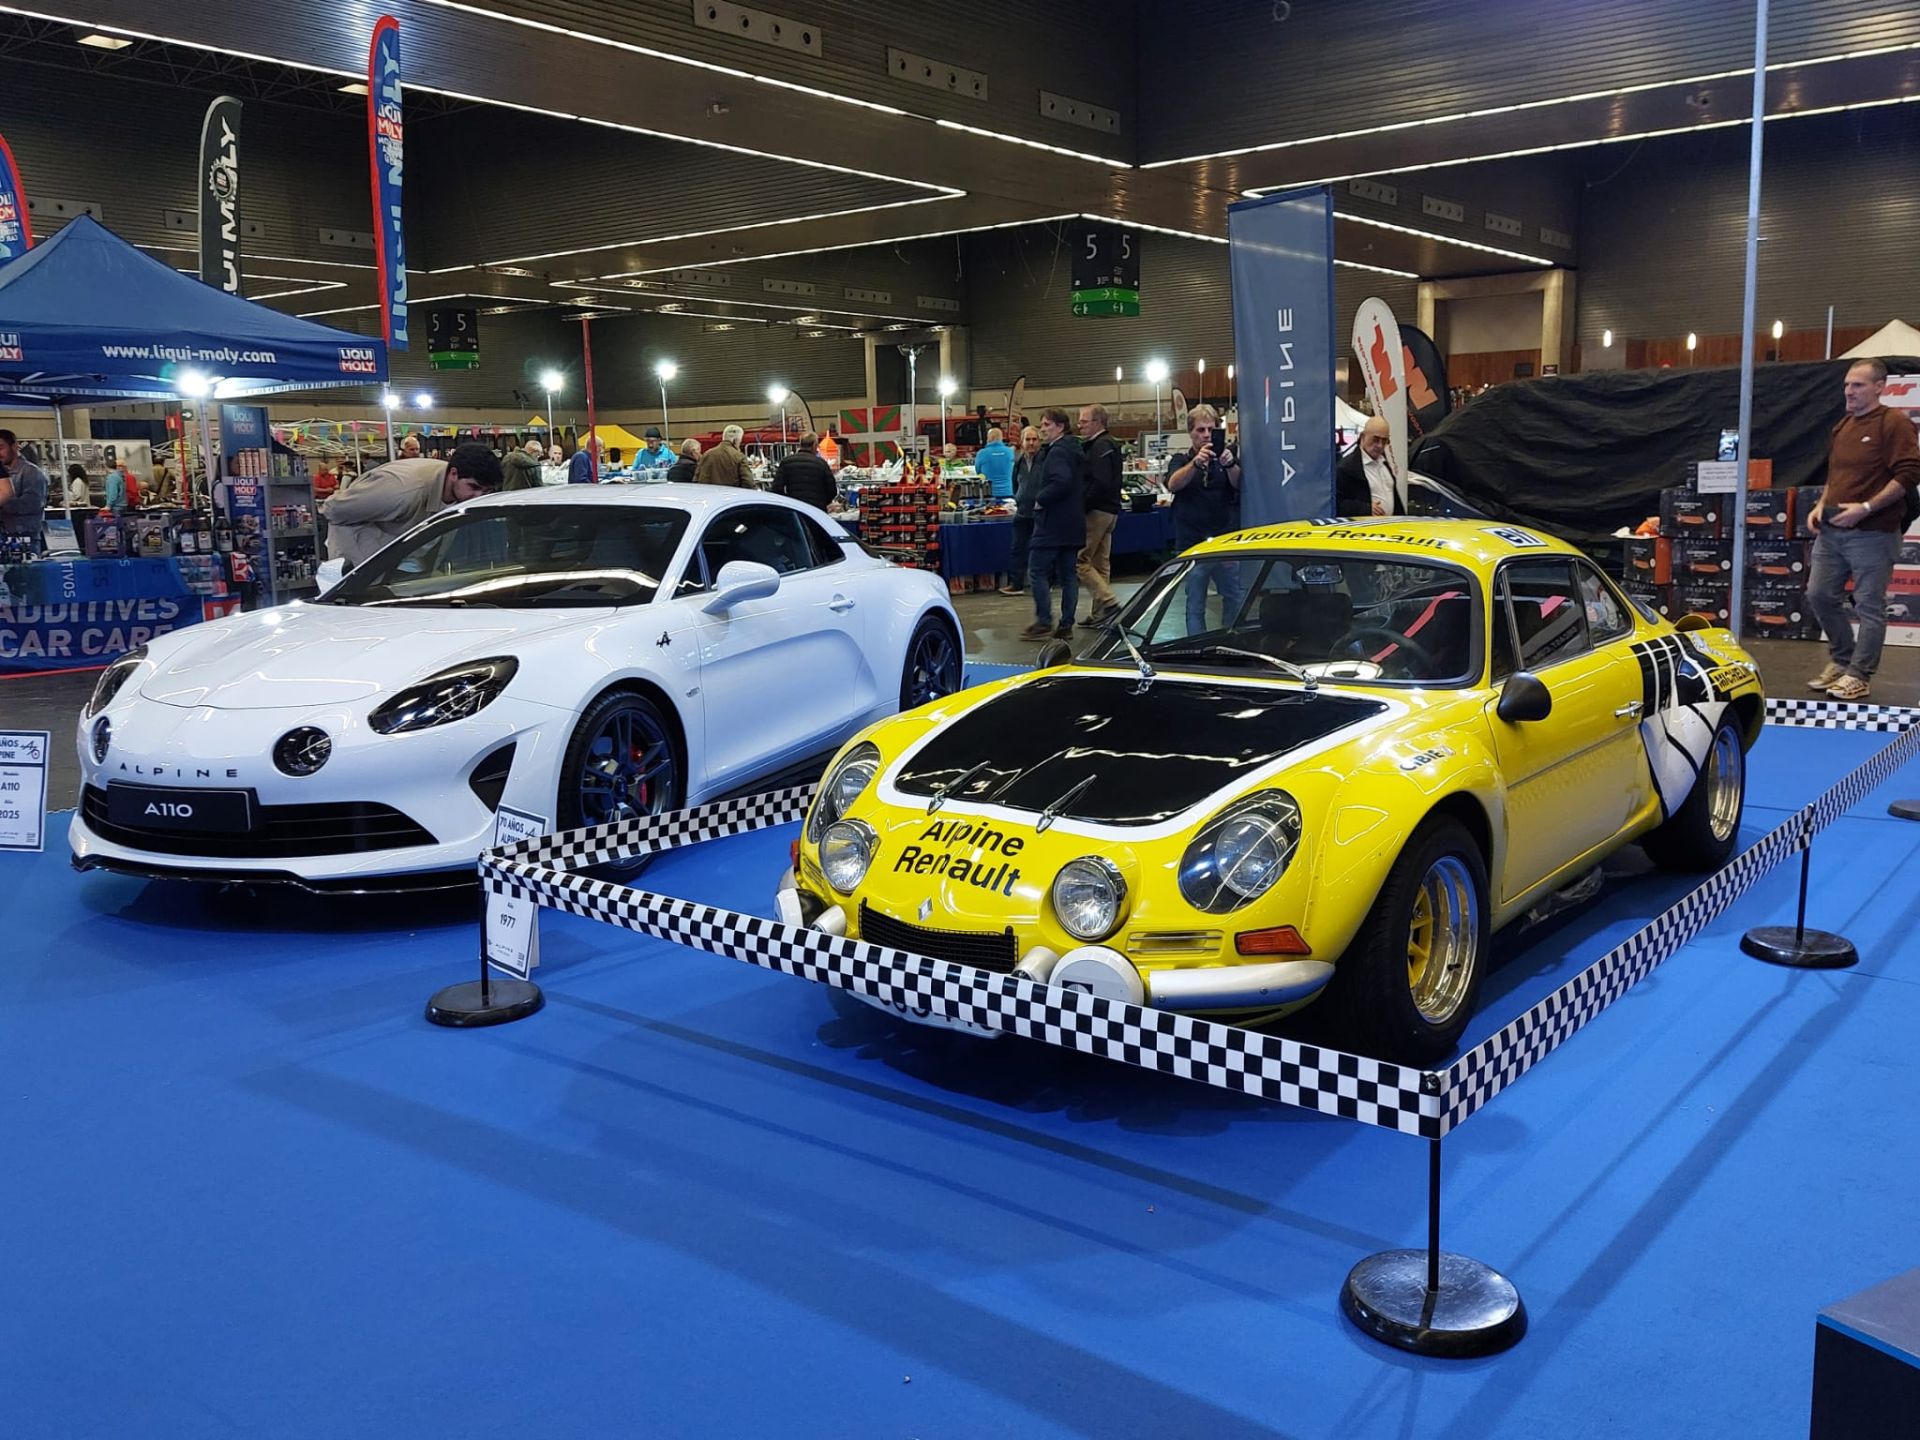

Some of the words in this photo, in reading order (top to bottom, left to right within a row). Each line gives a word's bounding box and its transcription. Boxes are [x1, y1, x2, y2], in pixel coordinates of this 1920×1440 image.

[1086, 234, 1097, 259] 5
[1122, 234, 1130, 259] 5
[432, 313, 440, 331] 5
[457, 313, 466, 331] 5
[102, 345, 276, 365] www.liqui-moly.com
[341, 349, 372, 360] LIQUI
[342, 360, 374, 371] MOLY
[1278, 308, 1296, 487] ALPINE
[1223, 530, 1313, 544] Alpine
[0, 629, 72, 658] CAR
[120, 762, 238, 778] ALPINE
[1, 782, 20, 791] A110
[144, 803, 193, 818] A110
[919, 821, 1025, 857] Alpine
[893, 845, 1021, 897] Renault
[500, 913, 516, 929] 1977
